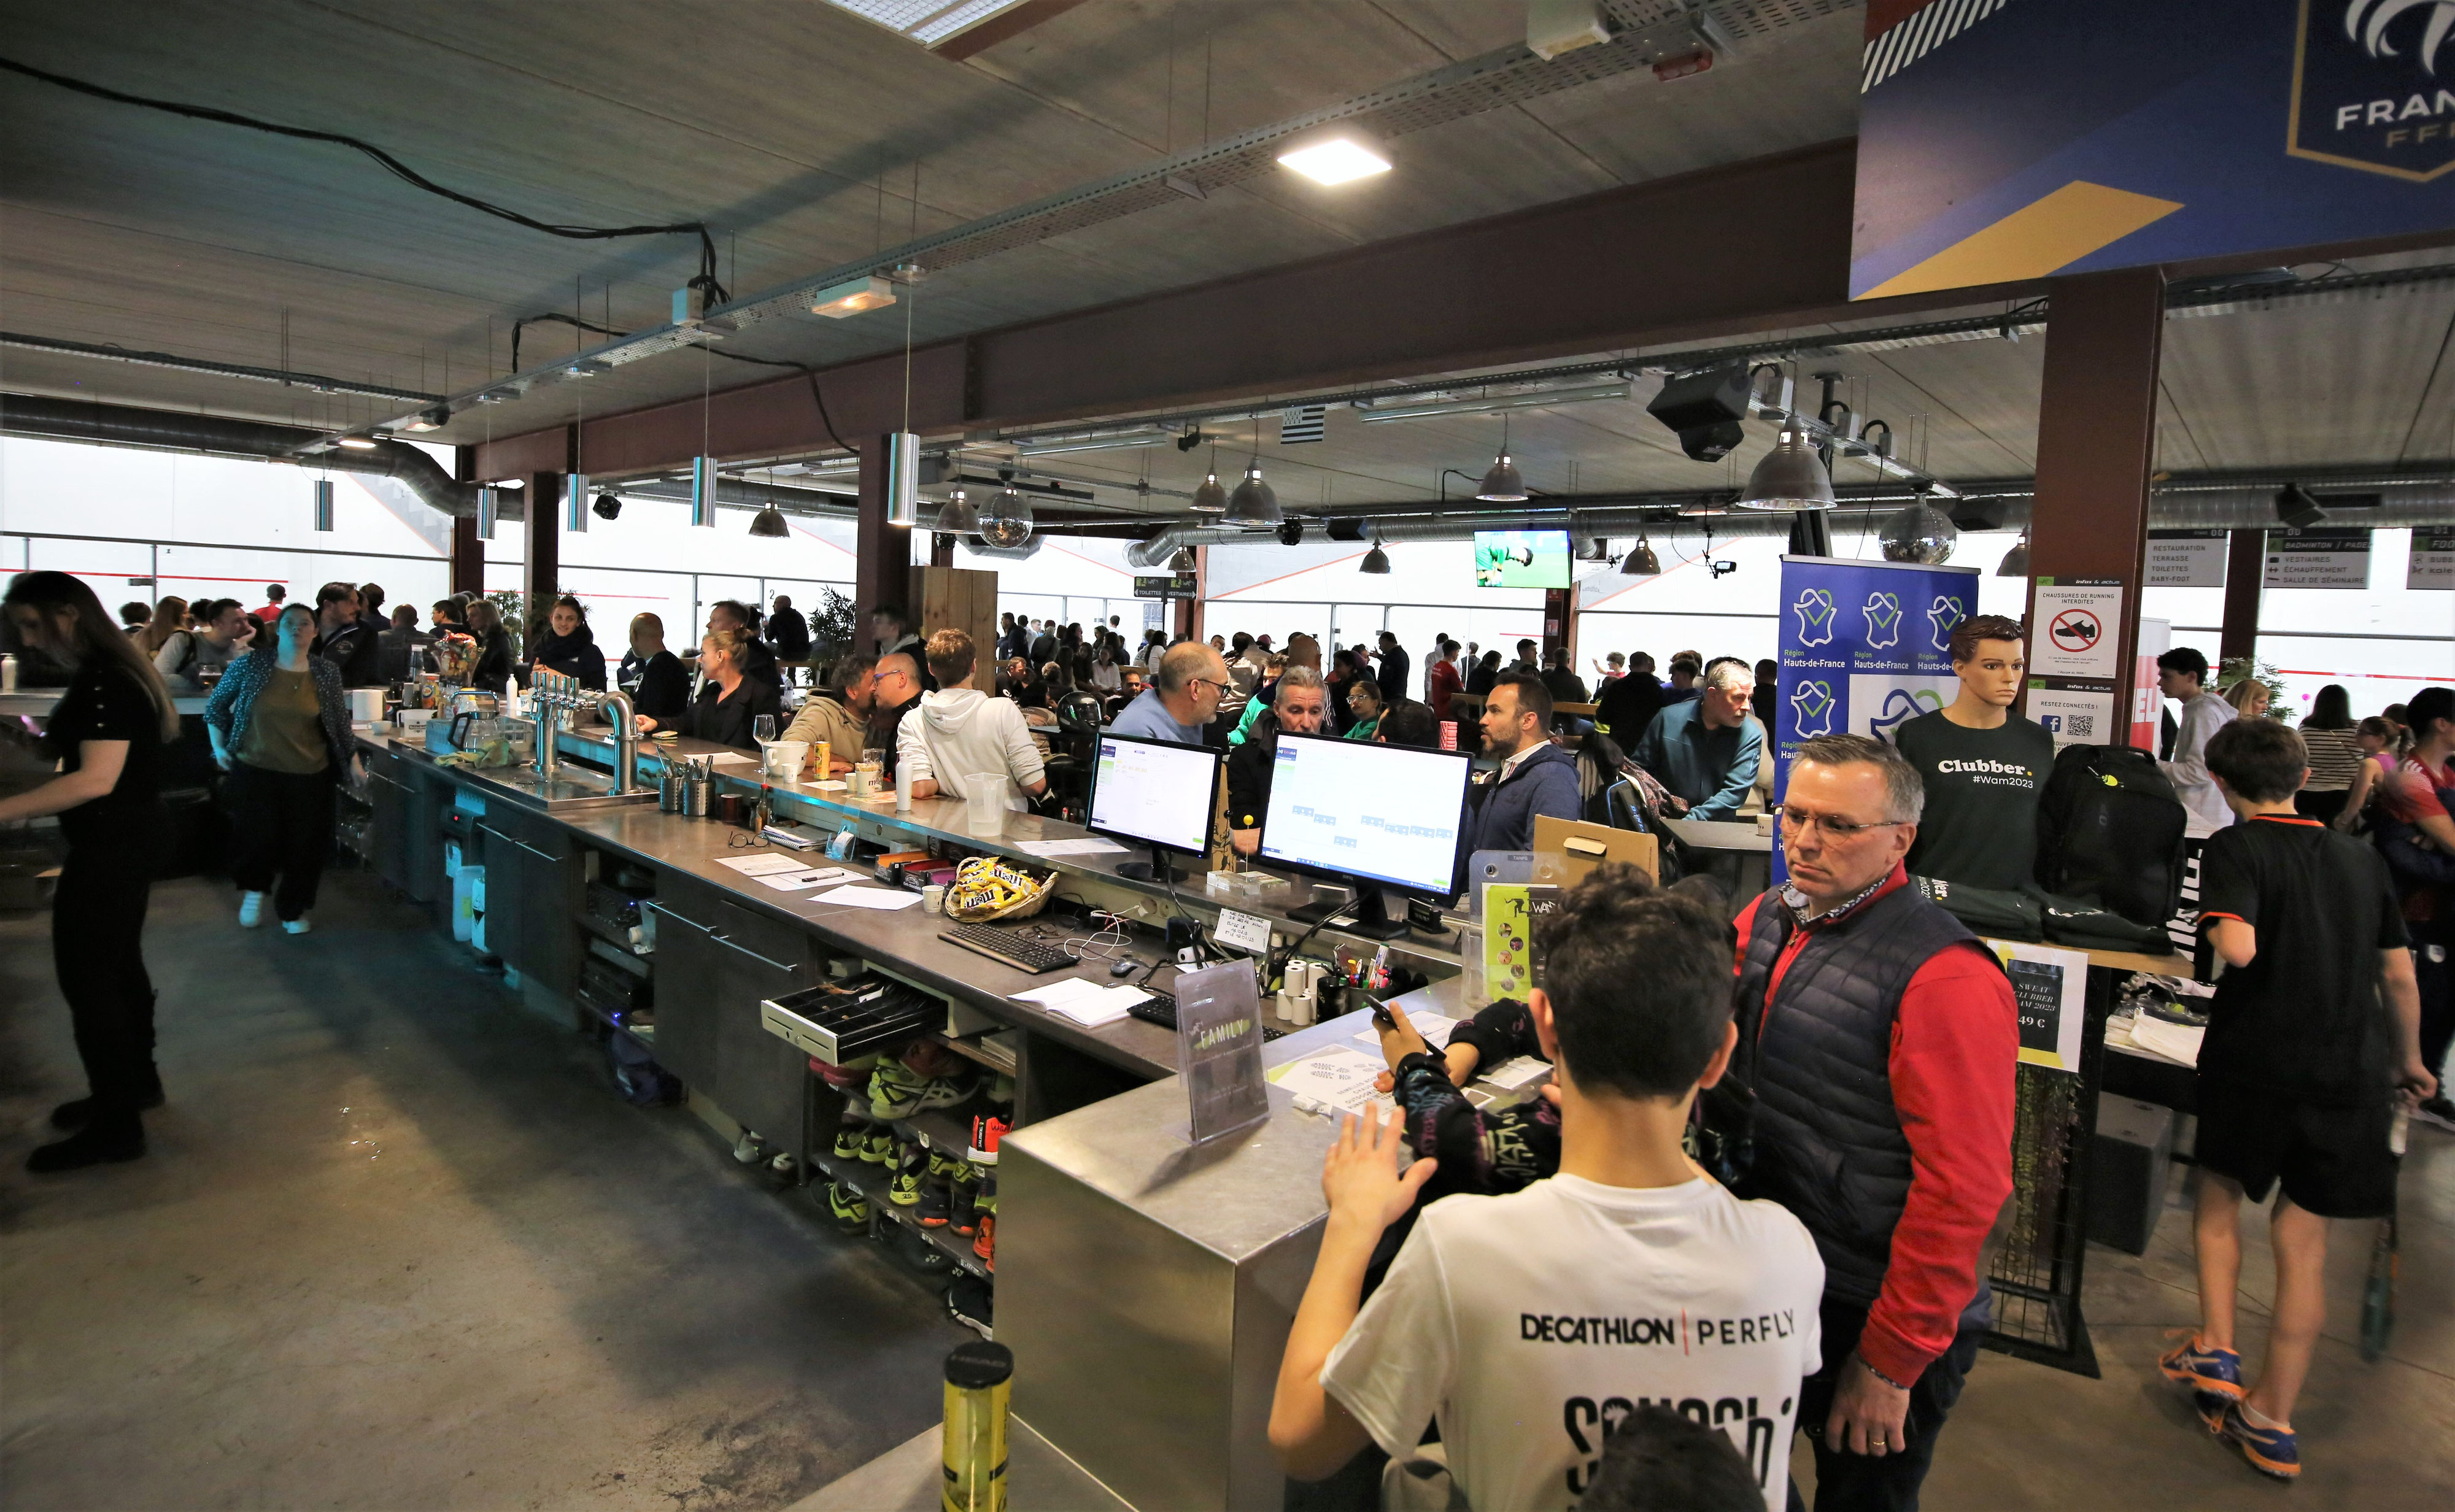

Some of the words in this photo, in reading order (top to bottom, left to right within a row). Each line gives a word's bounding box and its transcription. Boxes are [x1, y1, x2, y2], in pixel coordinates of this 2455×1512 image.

[2337, 89, 2455, 131] FRAN
[2386, 122, 2455, 148] FF
[770, 589, 775, 600] 2
[1784, 658, 1846, 668] Hauts-de-France
[1854, 660, 1909, 669] Hauts-de-France
[1918, 662, 1954, 671] Hauts-de-
[1938, 759, 2032, 776] Clubber.
[1973, 775, 2033, 789] #Wam2023
[2018, 983, 2050, 993] SWEAT
[2033, 1003, 2055, 1011] 2023
[2018, 1016, 2034, 1025] 49
[2037, 1019, 2045, 1028] €
[1200, 1019, 1245, 1050] FAMILY
[1521, 1313, 1675, 1344] DECATHLON
[1698, 1309, 1794, 1344] PERFLY
